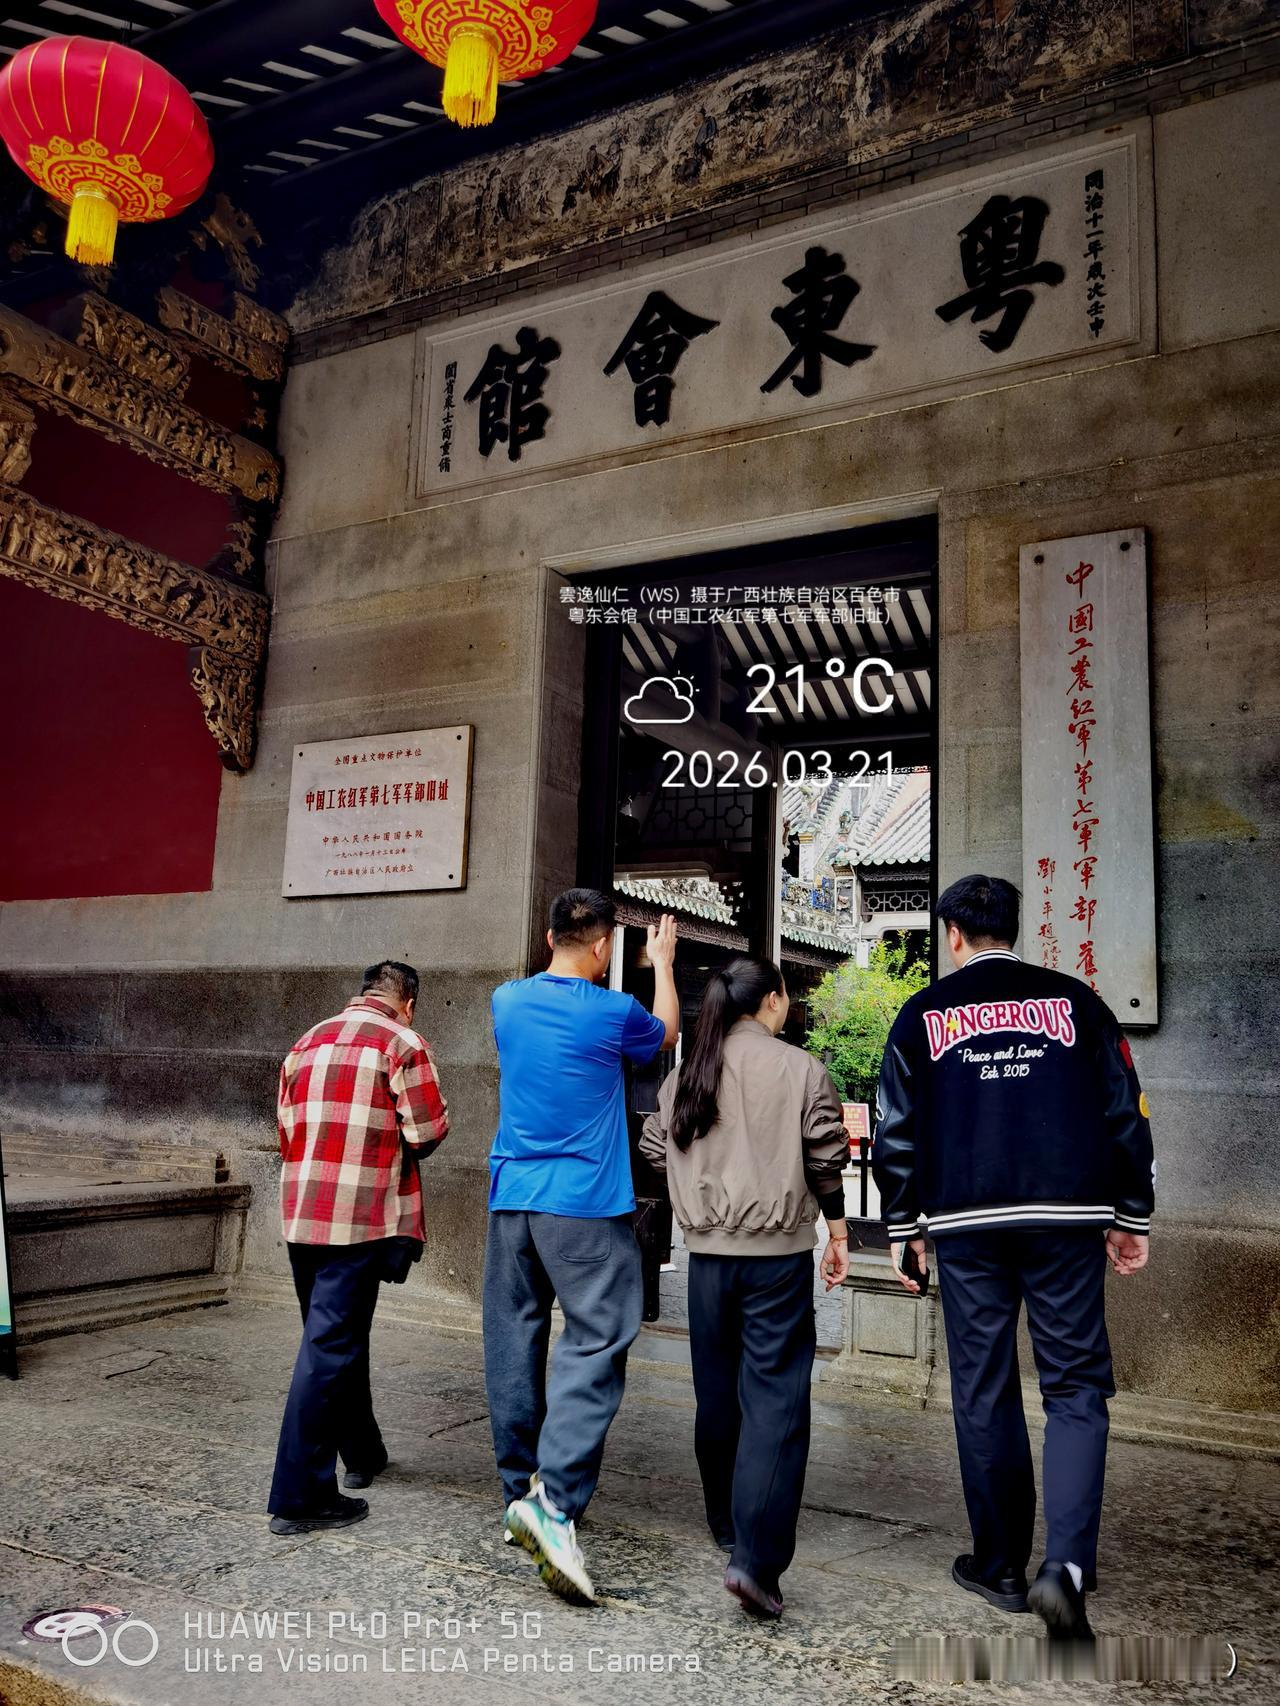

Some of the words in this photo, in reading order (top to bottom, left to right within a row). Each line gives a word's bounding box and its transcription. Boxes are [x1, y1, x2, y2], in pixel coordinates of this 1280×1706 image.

[335, 748, 422, 765] 全国重点文物保护单位
[305, 779, 449, 812] 中国工农红军第七军军部旧址
[322, 829, 424, 846] 中华人民共和国国务院
[923, 998, 1076, 1061] DANGEROUS
[993, 1046, 1015, 1060] and
[1003, 1064, 1030, 1077] 2015
